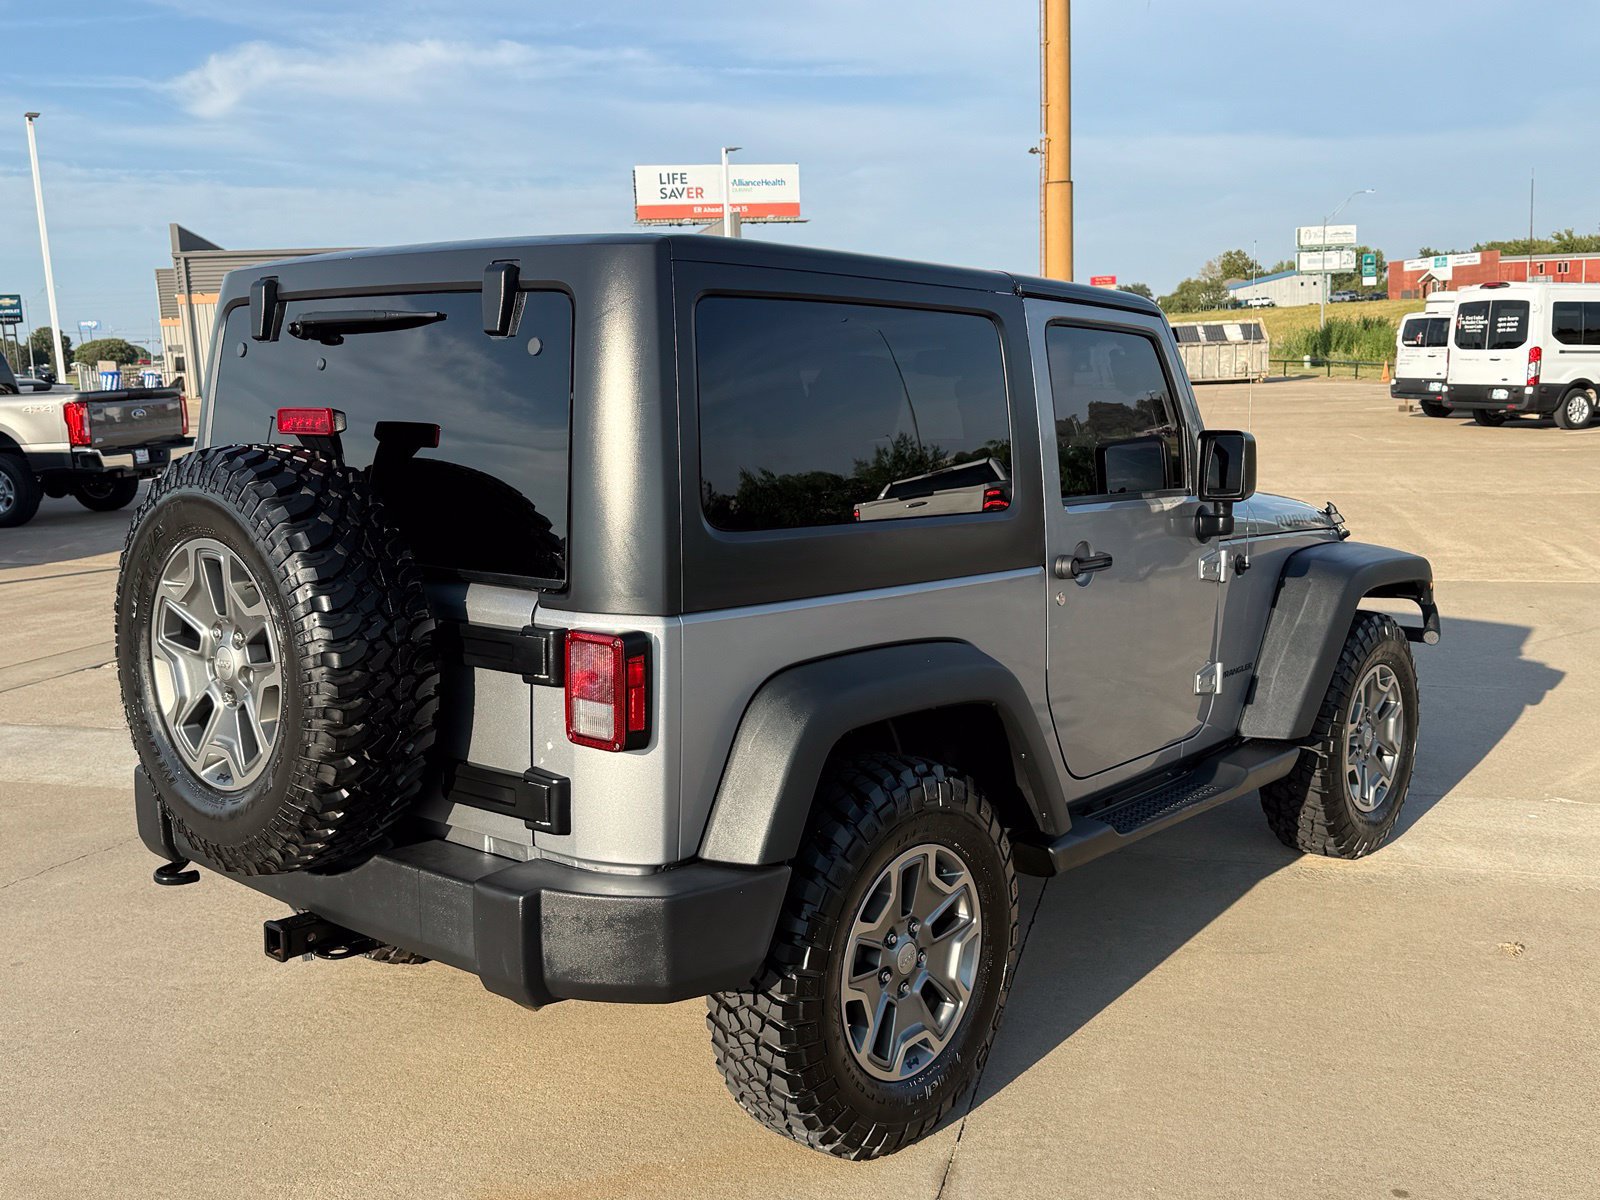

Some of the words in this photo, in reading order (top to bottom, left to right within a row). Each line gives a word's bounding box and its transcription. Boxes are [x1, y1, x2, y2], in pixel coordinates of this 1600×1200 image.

[659, 173, 688, 185] LIFE
[731, 178, 786, 187] AllianceHealth
[660, 187, 704, 199] SAVER
[1222, 662, 1253, 679] RANGLER
